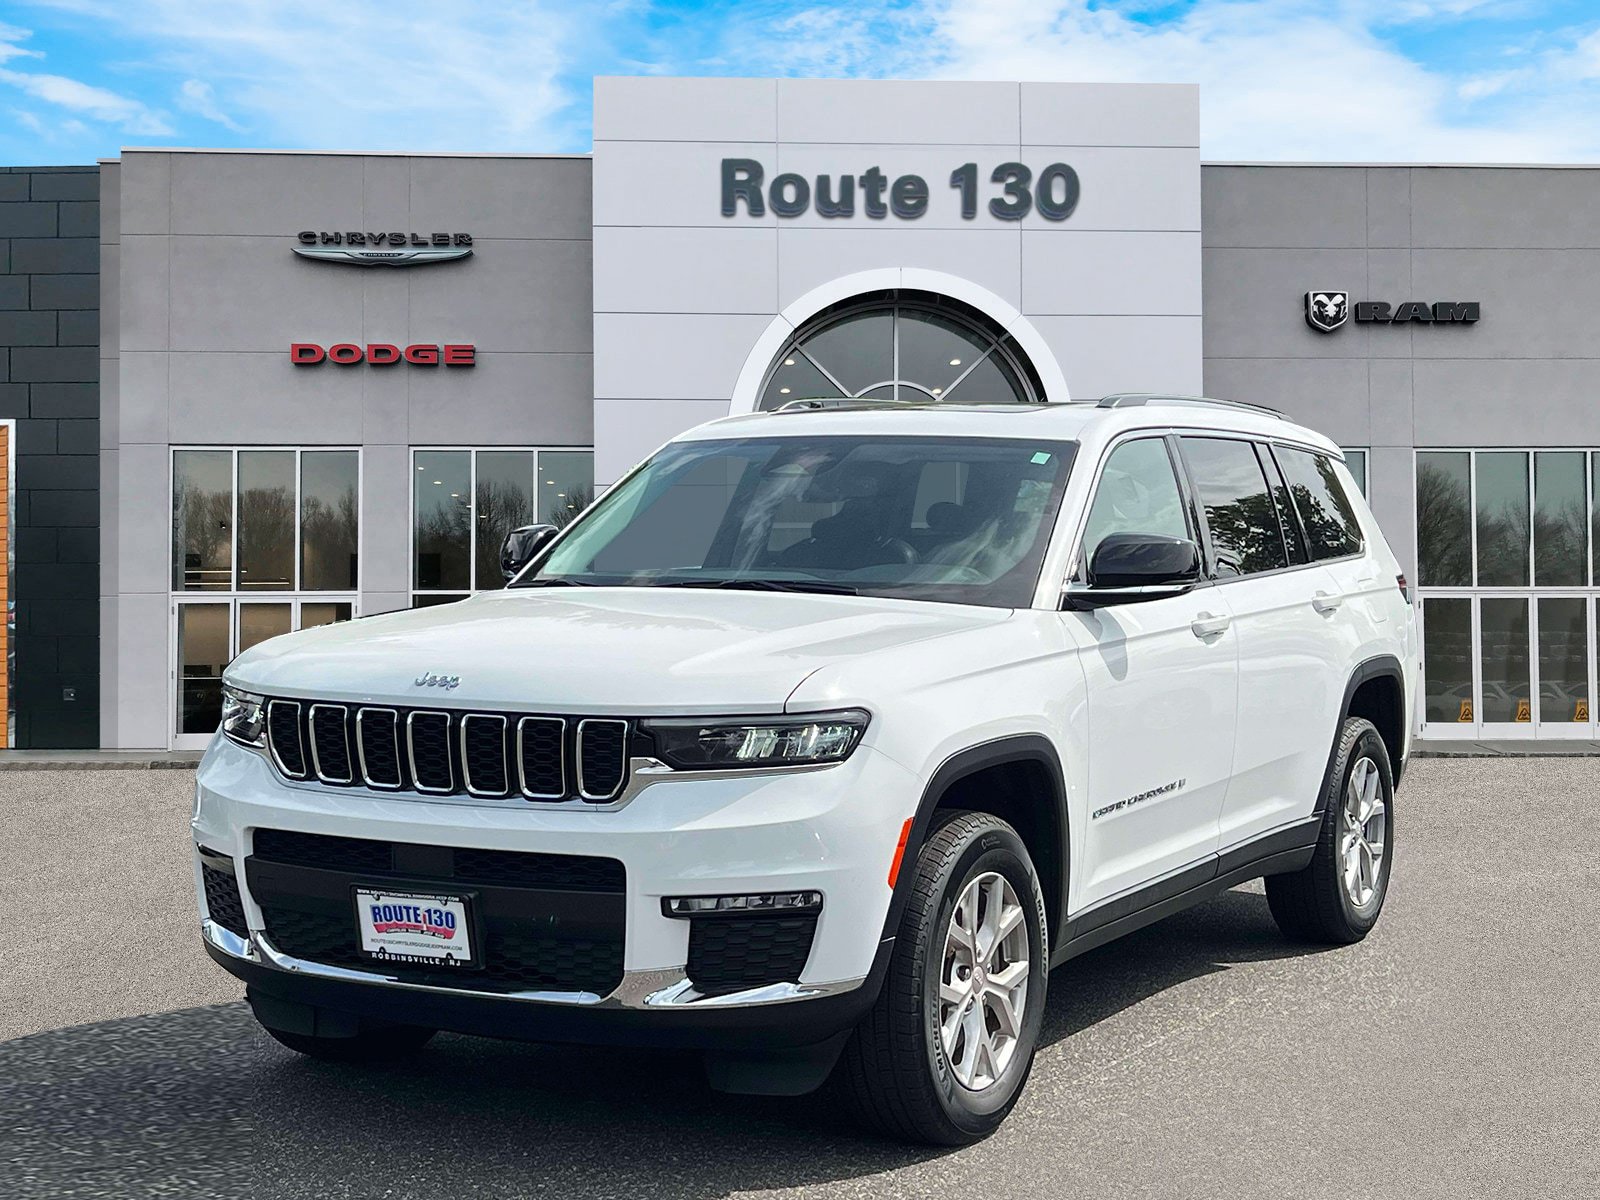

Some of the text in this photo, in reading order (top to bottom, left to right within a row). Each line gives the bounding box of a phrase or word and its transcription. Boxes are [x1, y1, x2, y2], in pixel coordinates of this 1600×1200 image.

[720, 158, 1080, 221] Route 130
[298, 231, 473, 246] CHRYSLER
[1355, 302, 1480, 323] RAM
[291, 343, 476, 365] DODGE
[415, 671, 460, 691] Jeep
[370, 904, 456, 929] ROUTE 130
[449, 959, 461, 967] NJ
[932, 990, 945, 1071] MICHELIN
